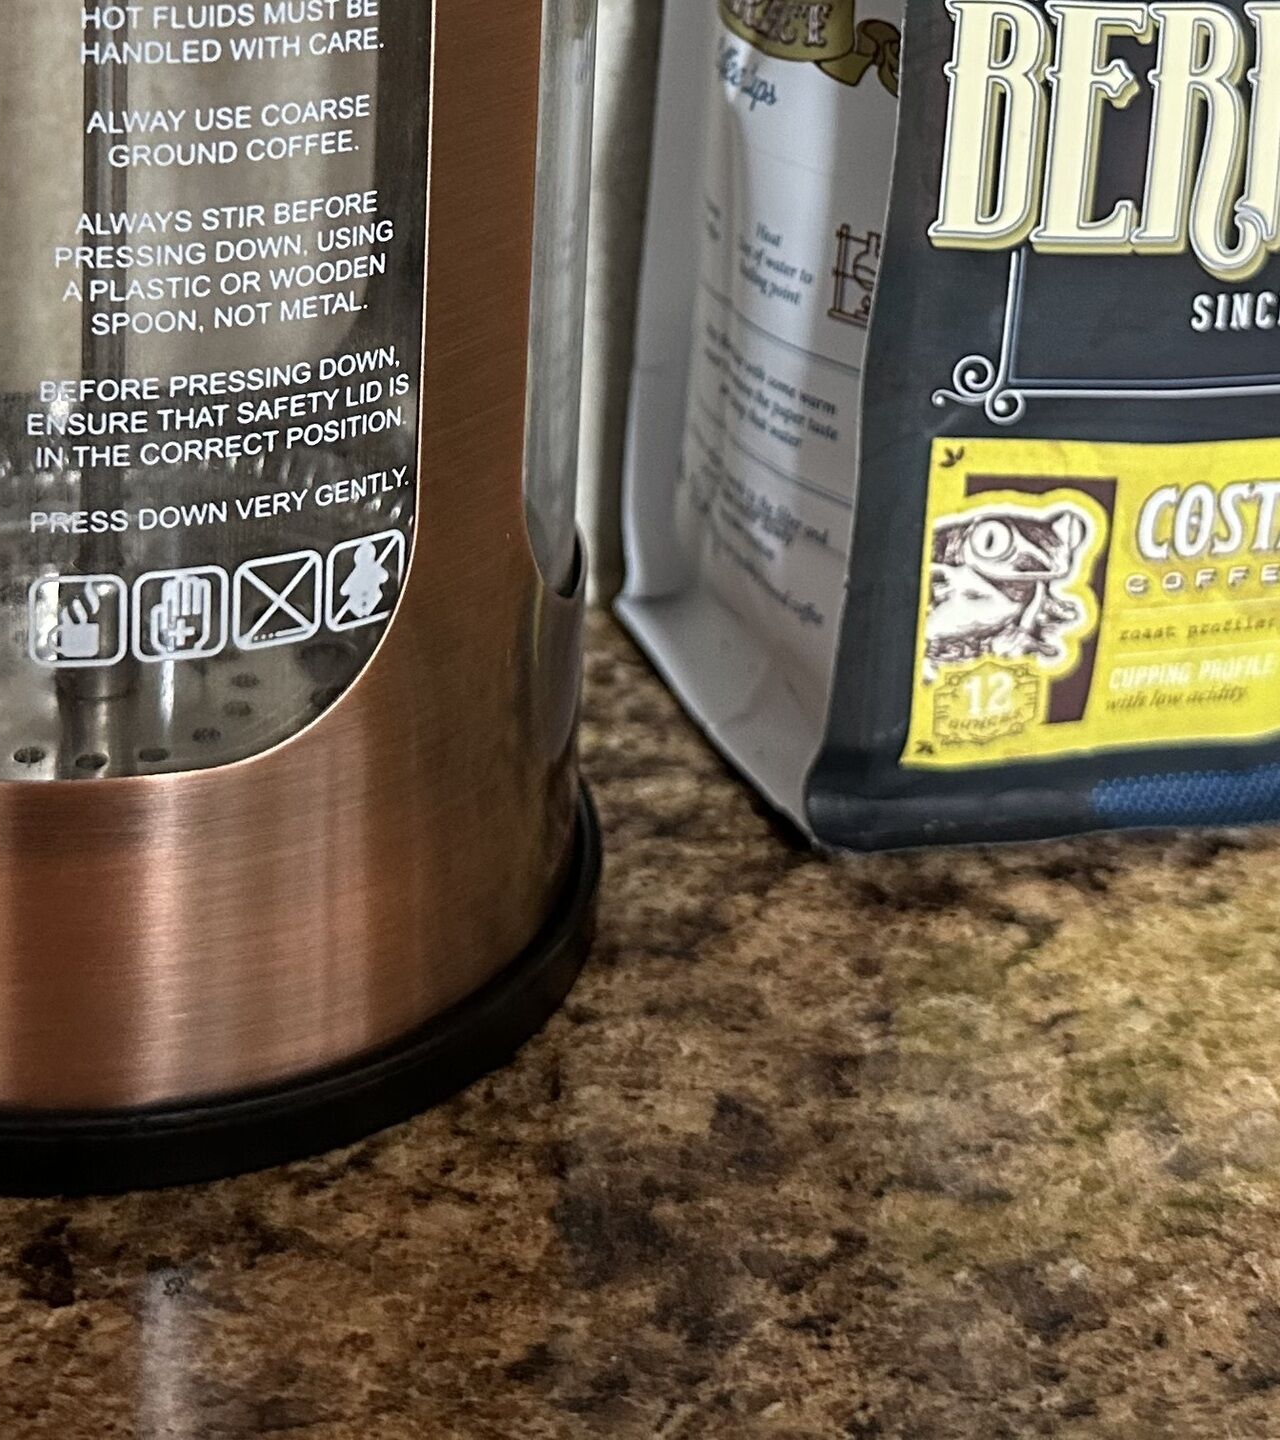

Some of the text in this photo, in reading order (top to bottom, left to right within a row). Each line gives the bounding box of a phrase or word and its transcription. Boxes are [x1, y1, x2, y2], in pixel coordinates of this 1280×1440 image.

[80, 5, 144, 31] HOT
[152, 2, 256, 30] FLUIDS
[80, 26, 385, 65] HANDLED WITH CARE.
[86, 94, 372, 134] ALWAY USE COARSE
[107, 130, 361, 169] GROUND COFFEE.
[75, 190, 379, 237] ALWAYS STIR BEFORE
[54, 220, 395, 269] PRESSING DOWN, USING
[62, 252, 387, 302] A PLASTIC OR WOODEN
[90, 290, 369, 338] SPOON, NOT METAL.
[39, 346, 402, 405] BEFORE PRESSING DOWN,
[26, 373, 410, 437] ENSURE THAT SAFETY LID IS
[36, 406, 407, 470] IN THE CORRECT POSITION.
[29, 466, 410, 536] PRESS DOWN VERY GENTLY.
[963, 671, 1014, 719] 12
[1108, 660, 1194, 692] CUPPING
